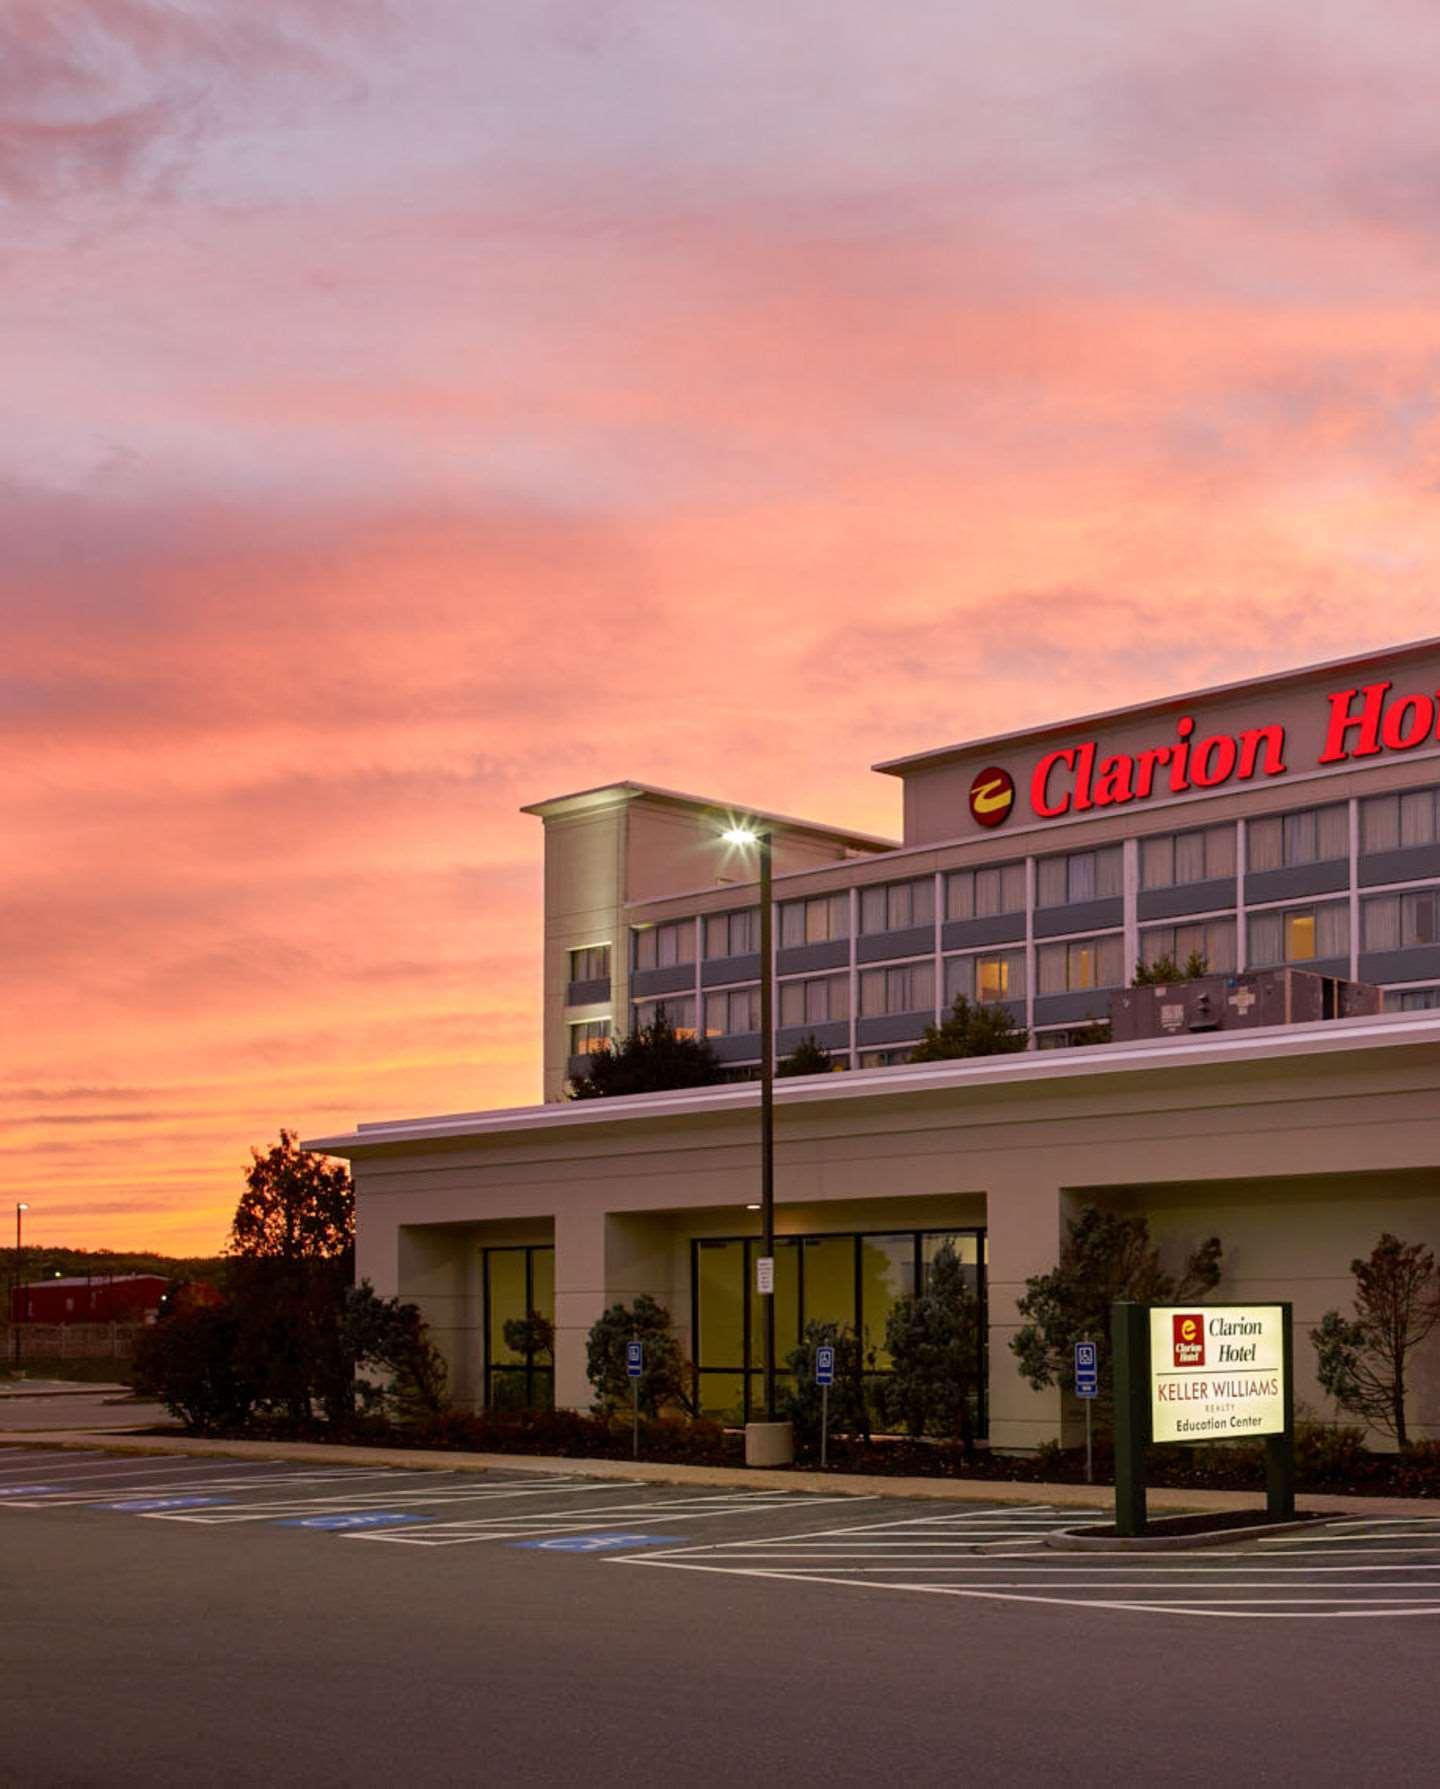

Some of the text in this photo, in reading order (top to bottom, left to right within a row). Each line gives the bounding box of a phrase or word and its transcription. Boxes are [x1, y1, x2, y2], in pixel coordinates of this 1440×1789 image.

[1030, 716, 1287, 818] Clarion
[1209, 1316, 1262, 1337] Clarion
[1218, 1343, 1257, 1363] Hotel
[1158, 1378, 1279, 1402] KELLER WILLIAMS
[1205, 1404, 1235, 1413] REALTY
[1176, 1416, 1262, 1432] Education Center
